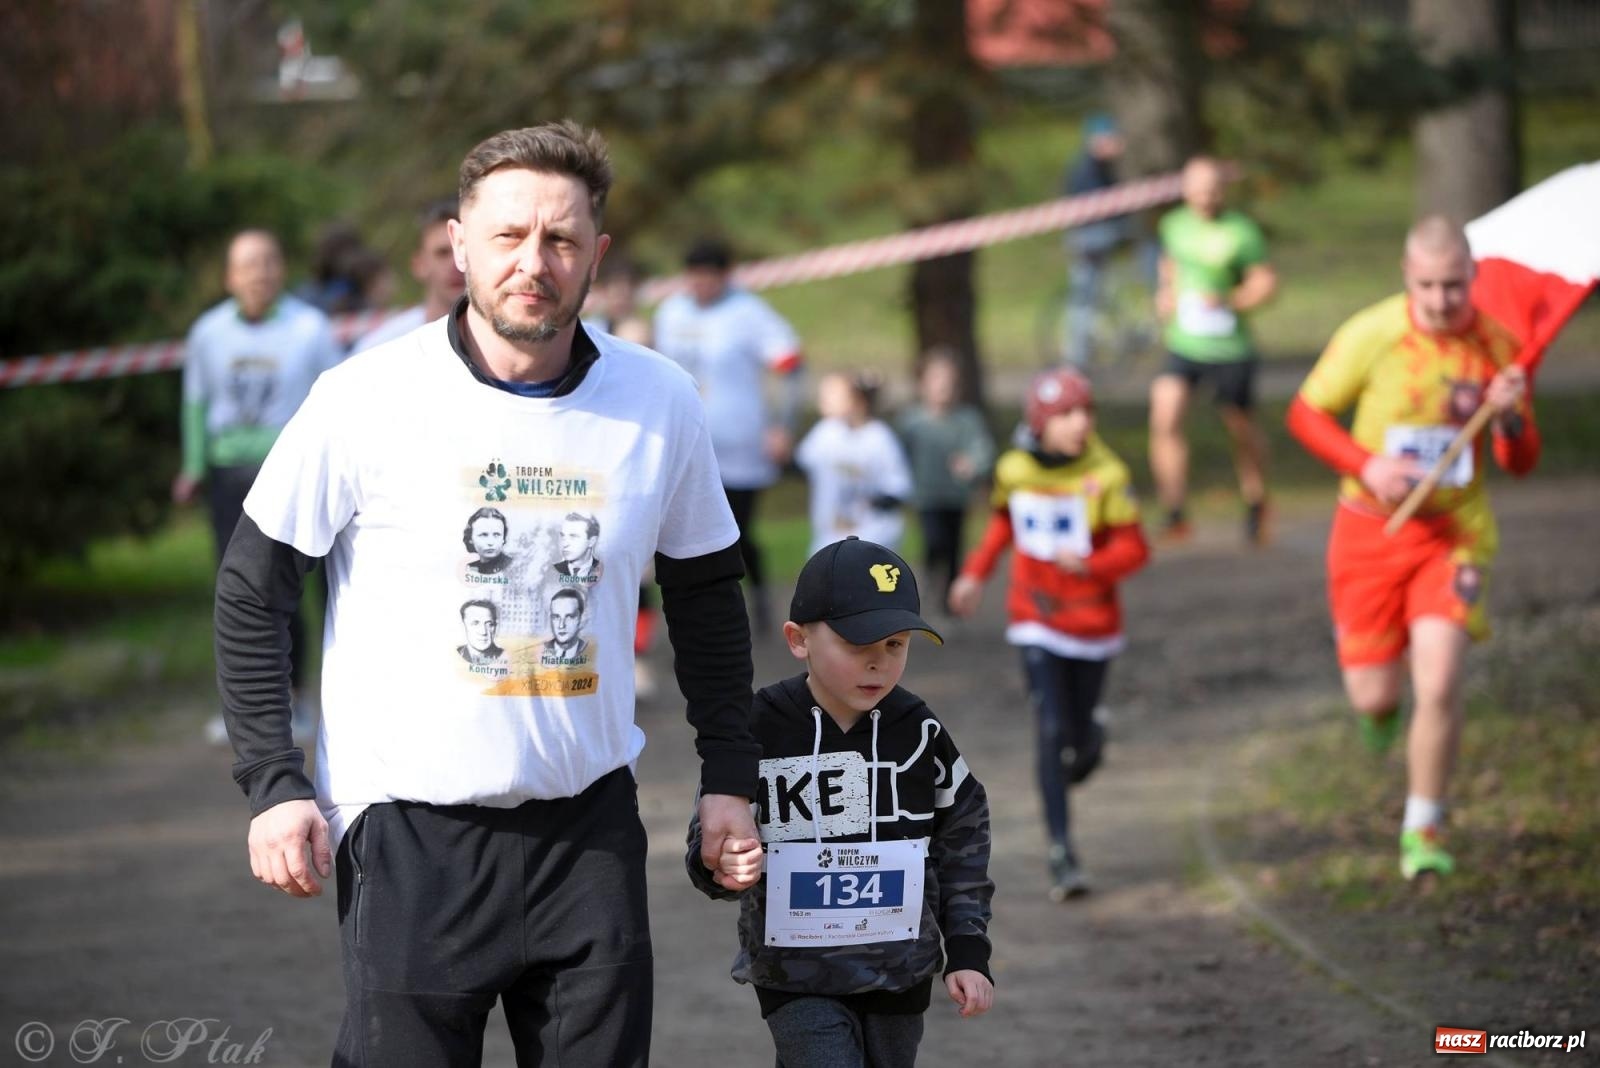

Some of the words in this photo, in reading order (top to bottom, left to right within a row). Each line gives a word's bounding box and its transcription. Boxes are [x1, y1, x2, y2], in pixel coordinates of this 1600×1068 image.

[516, 466, 553, 477] TROPEM
[517, 479, 587, 496] WILCZYM
[464, 573, 509, 584] Stolarska
[559, 574, 598, 584] Rodowicz
[541, 655, 587, 665] Miatkowski
[469, 664, 508, 676] Kontrym
[571, 678, 593, 691] 2024
[759, 769, 845, 825] IKE
[838, 855, 879, 866] WILCZYM
[815, 873, 883, 906] 134
